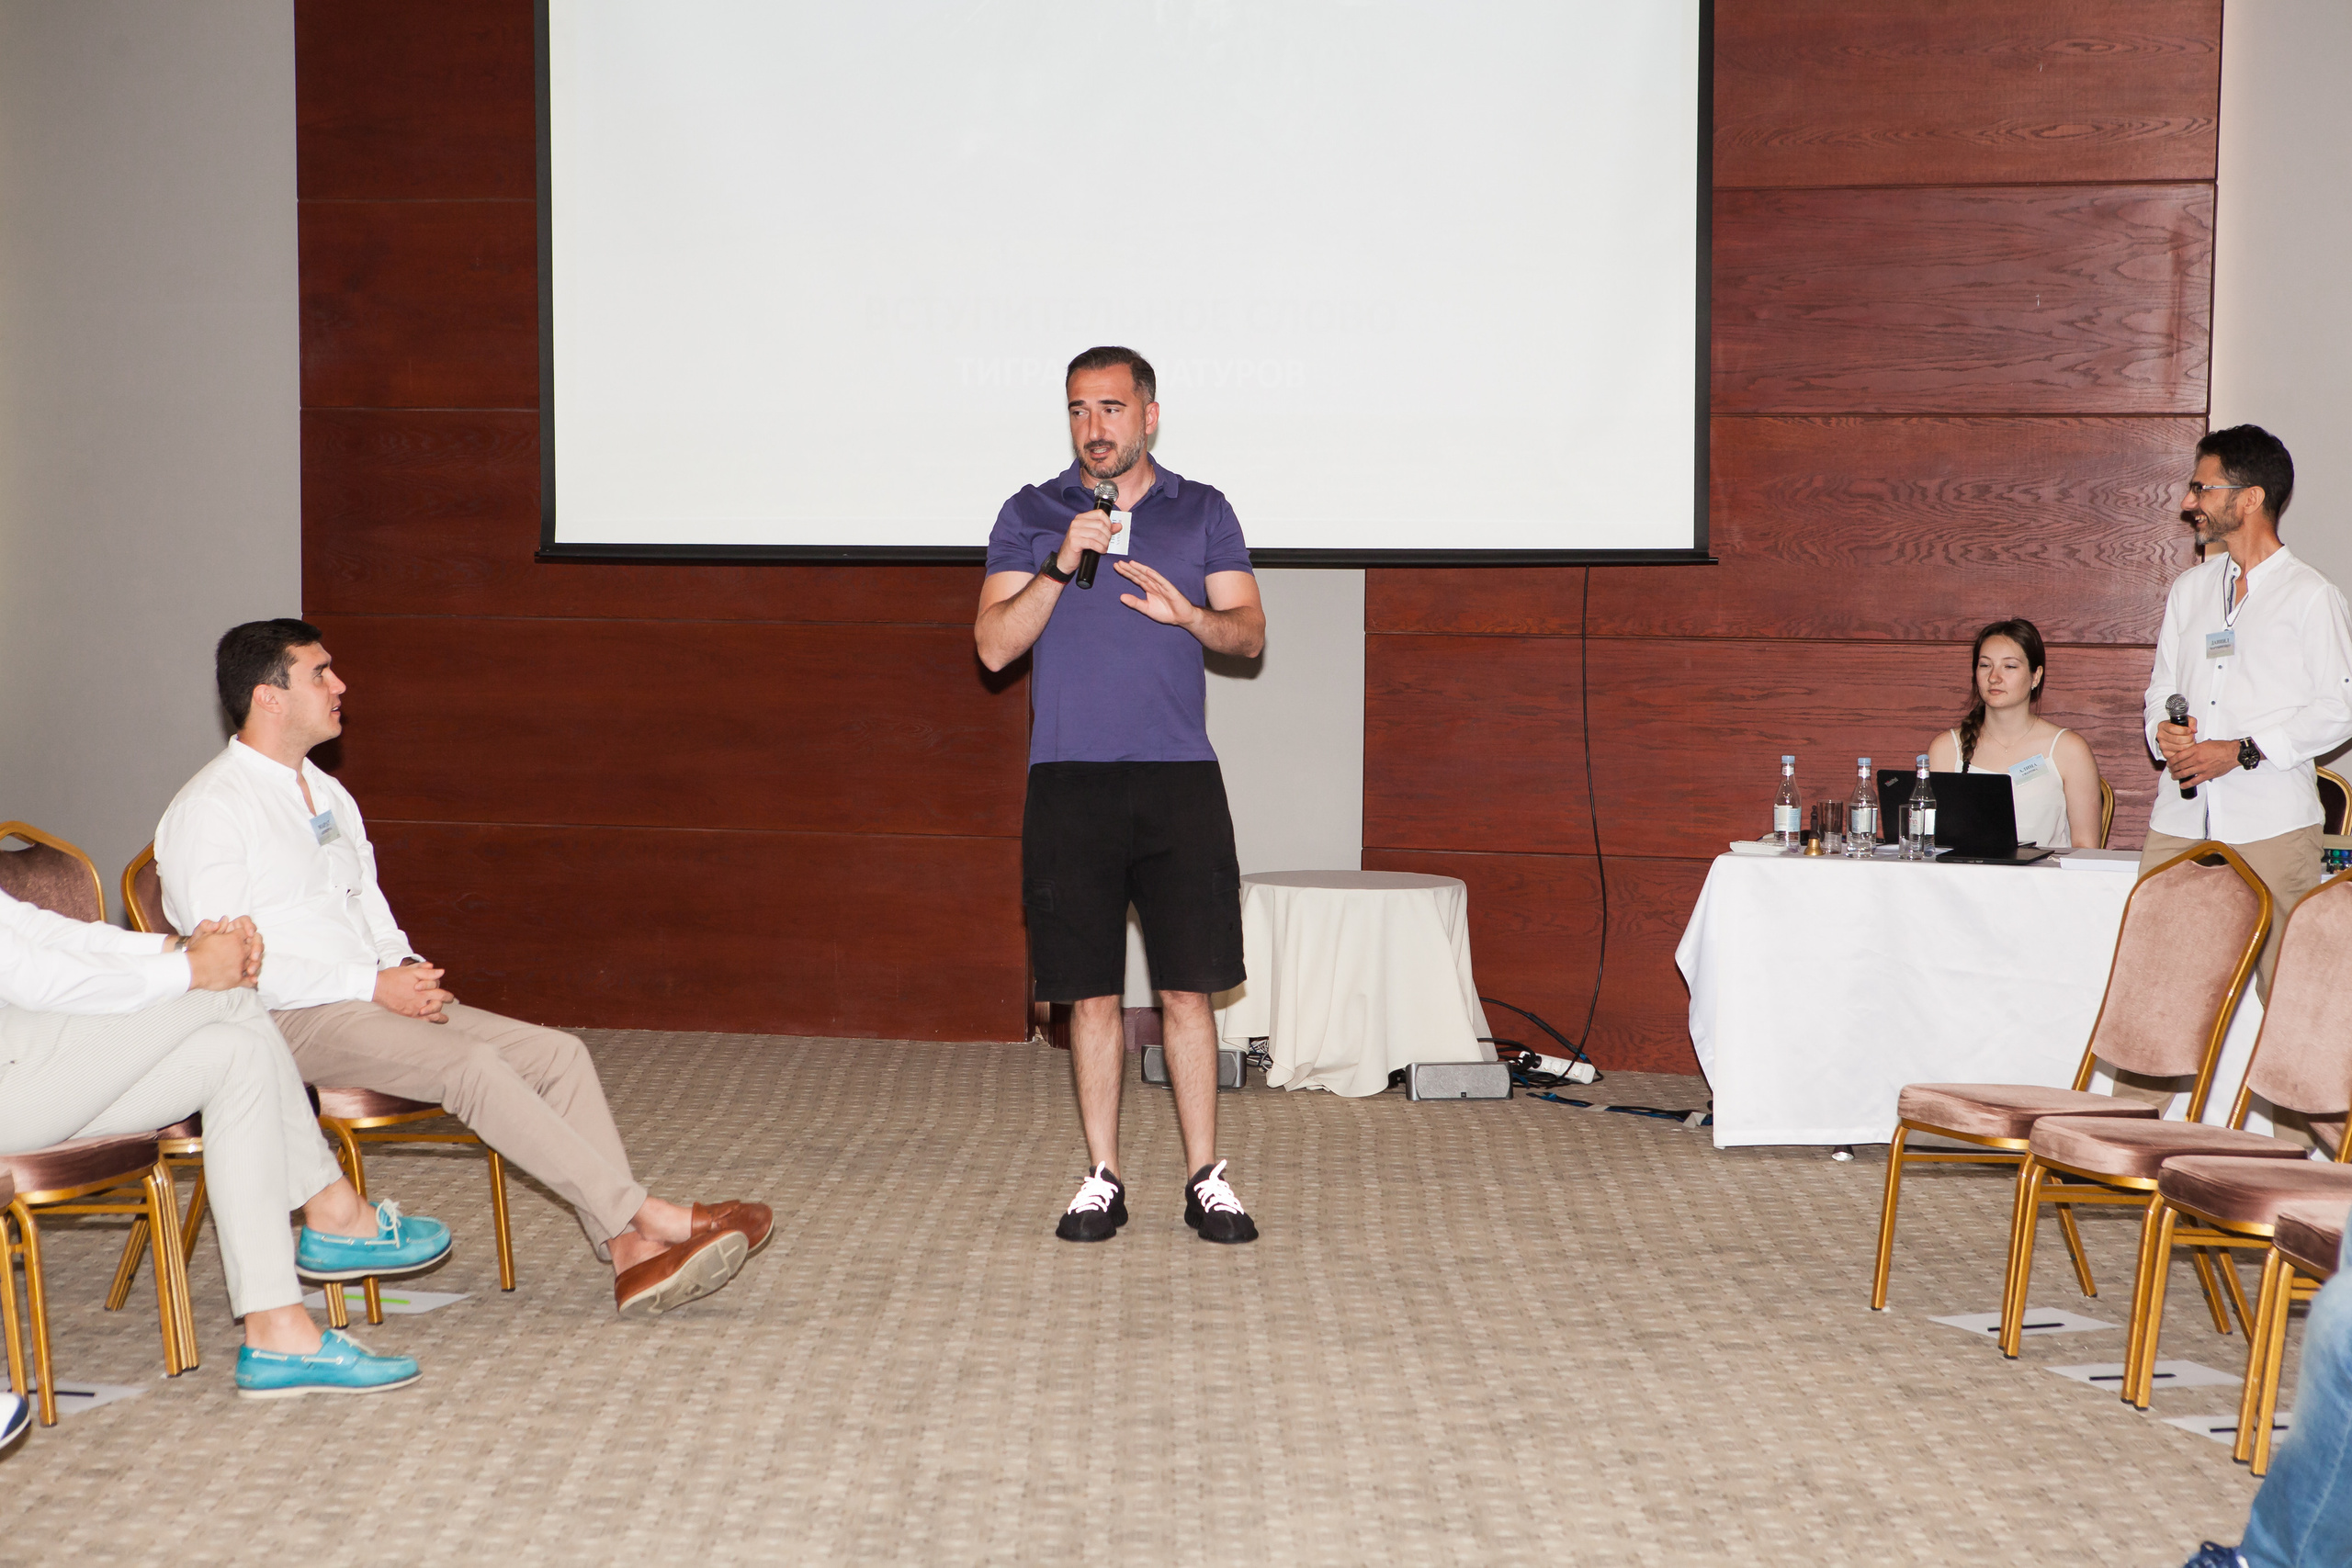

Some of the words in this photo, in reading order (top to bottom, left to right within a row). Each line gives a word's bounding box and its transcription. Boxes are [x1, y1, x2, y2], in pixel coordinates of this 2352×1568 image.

[864, 294, 1231, 333] ВСТУПИТЕЛЬНОЕ
[1245, 298, 1397, 334] СЛОВО
[955, 356, 1064, 392] ТИГРА
